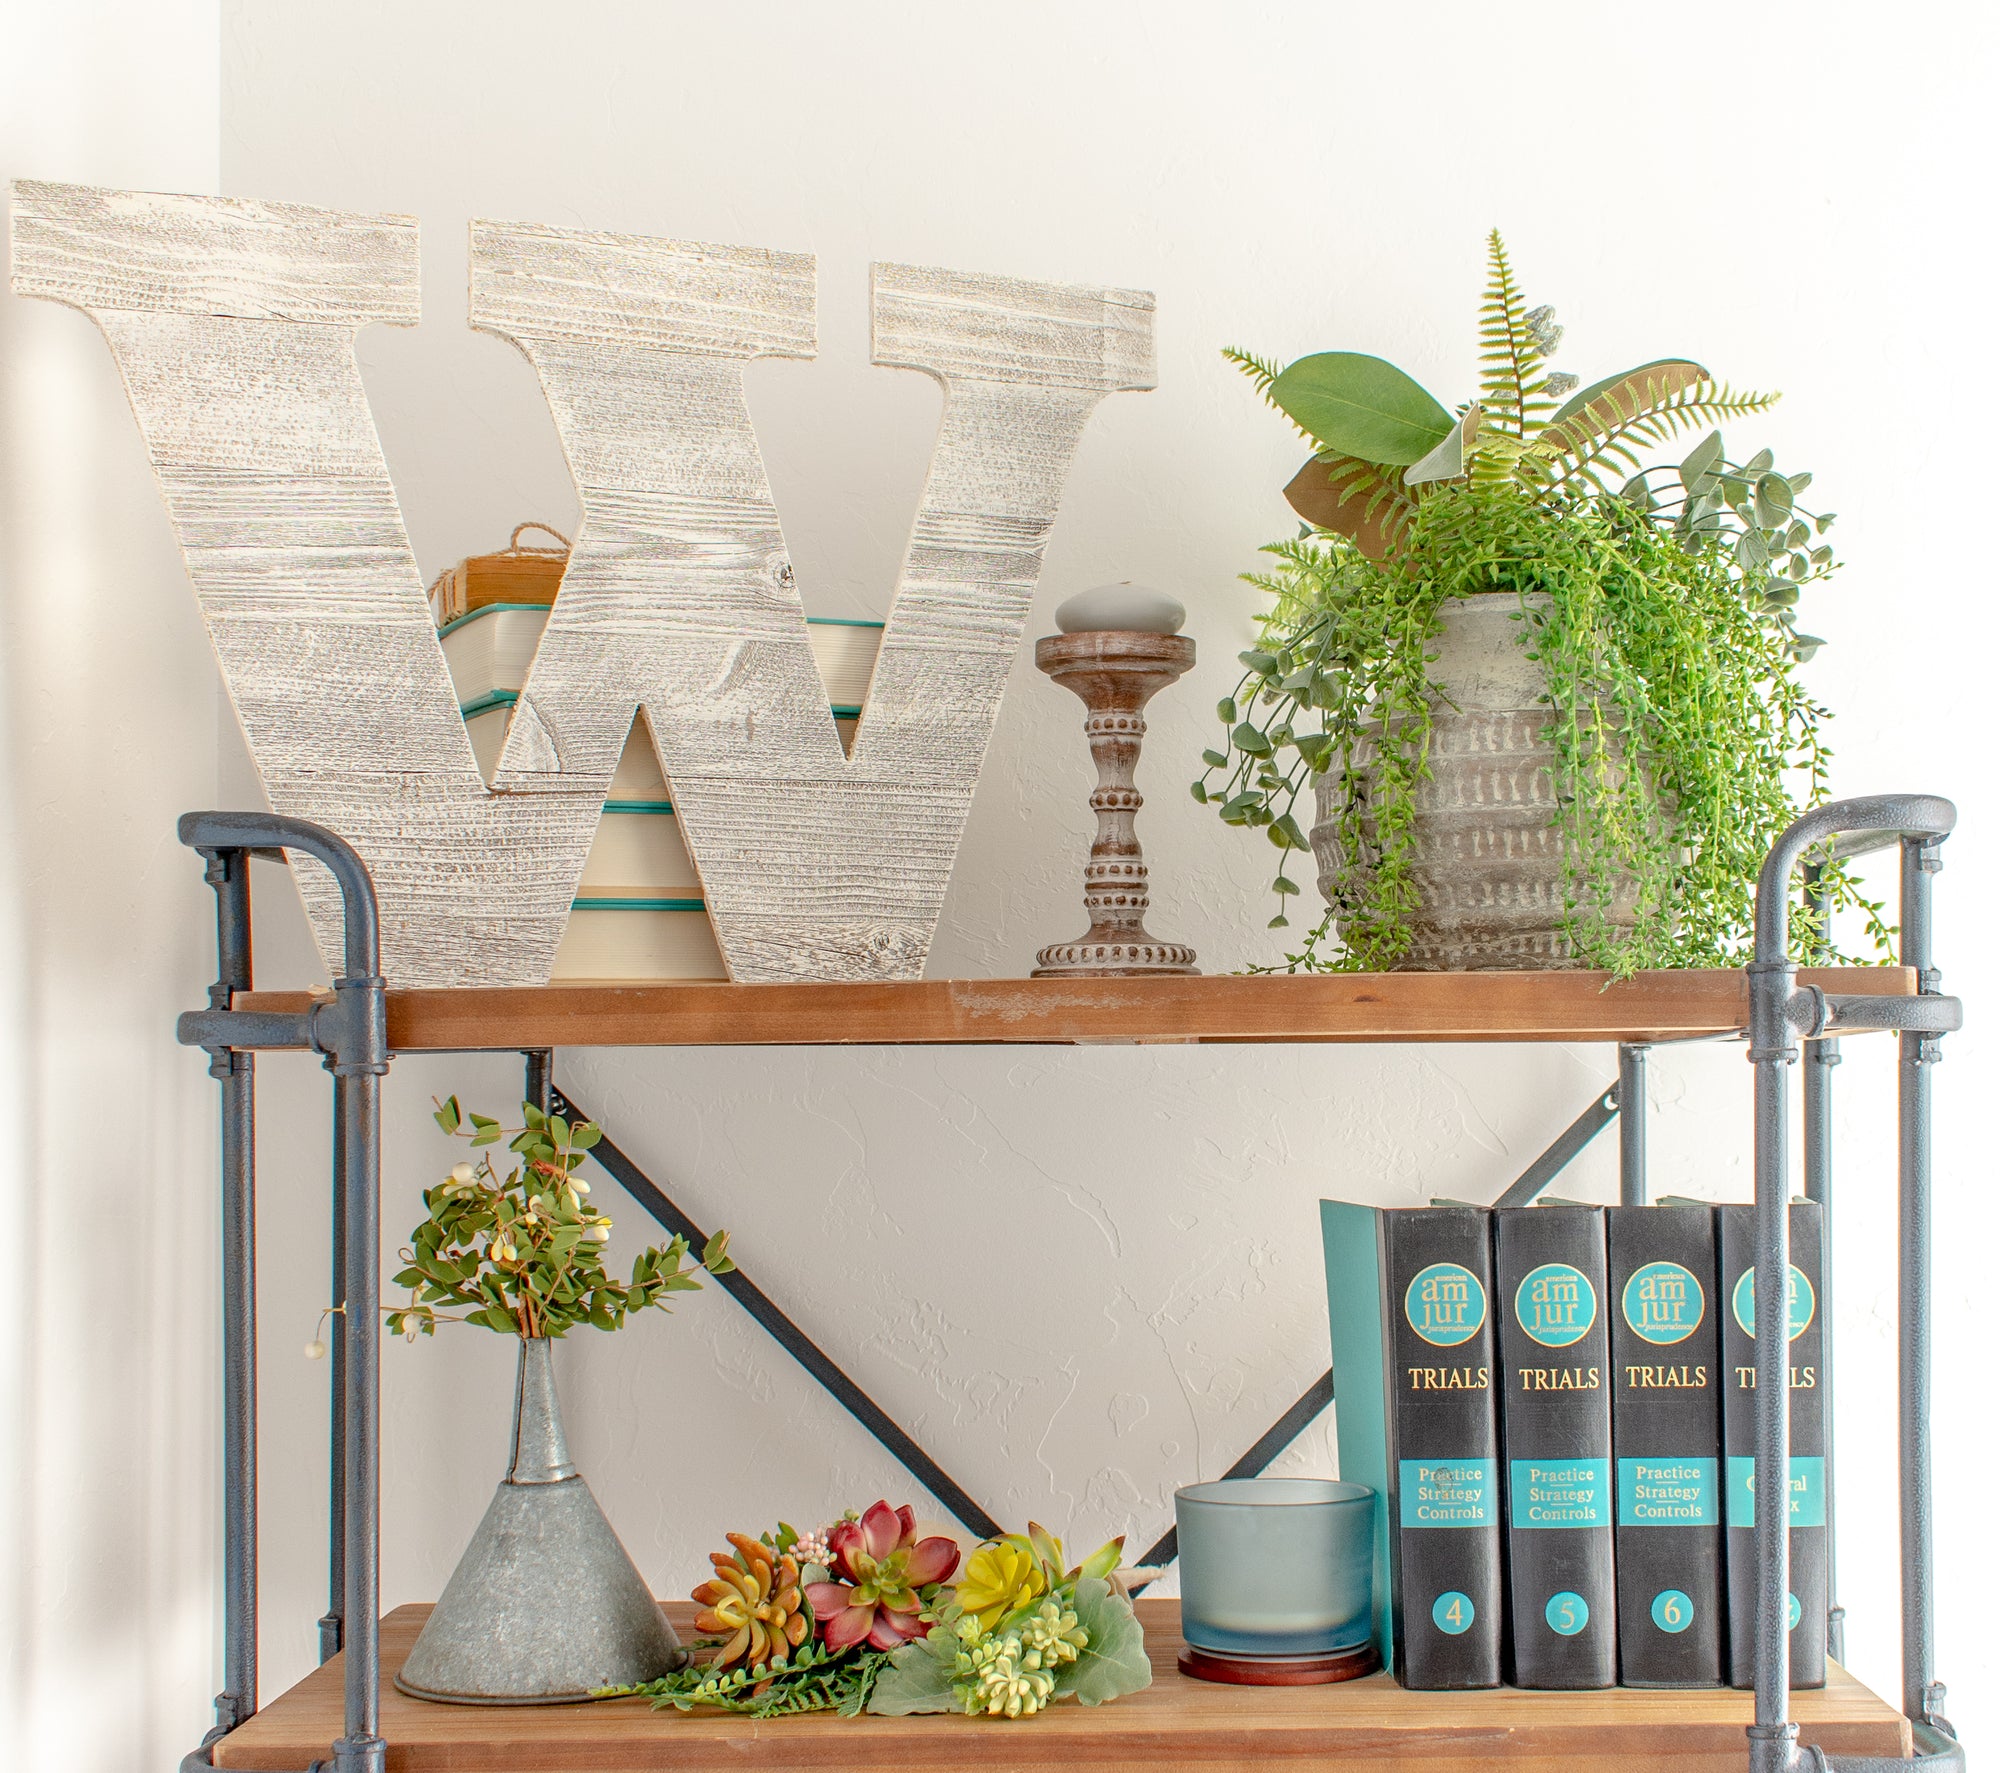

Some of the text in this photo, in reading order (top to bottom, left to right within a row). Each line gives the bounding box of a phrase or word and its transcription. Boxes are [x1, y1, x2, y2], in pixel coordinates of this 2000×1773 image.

[10, 178, 1158, 986] W
[1421, 1277, 1469, 1302] am
[1532, 1278, 1579, 1302] am
[1639, 1277, 1687, 1300] am
[1419, 1302, 1468, 1330] jur
[1530, 1302, 1579, 1331] jur
[1636, 1300, 1686, 1328] jur
[1408, 1367, 1489, 1390] TRIALS
[1519, 1368, 1600, 1390] TRIALS
[1625, 1366, 1707, 1388] TRIALS
[1735, 1366, 1816, 1389] TLS
[1419, 1467, 1483, 1481] Practice
[1530, 1468, 1595, 1482] Practice
[1636, 1465, 1701, 1480] Practice
[1418, 1487, 1482, 1502] Strategy
[1529, 1487, 1595, 1503] Strategy
[1635, 1485, 1701, 1501] Strategy
[1417, 1505, 1484, 1519] Controls
[1528, 1507, 1597, 1520] Controls
[1634, 1504, 1703, 1518] Controls
[1445, 1599, 1463, 1627] 4
[1559, 1600, 1576, 1629] 5
[1664, 1597, 1681, 1625] 6
